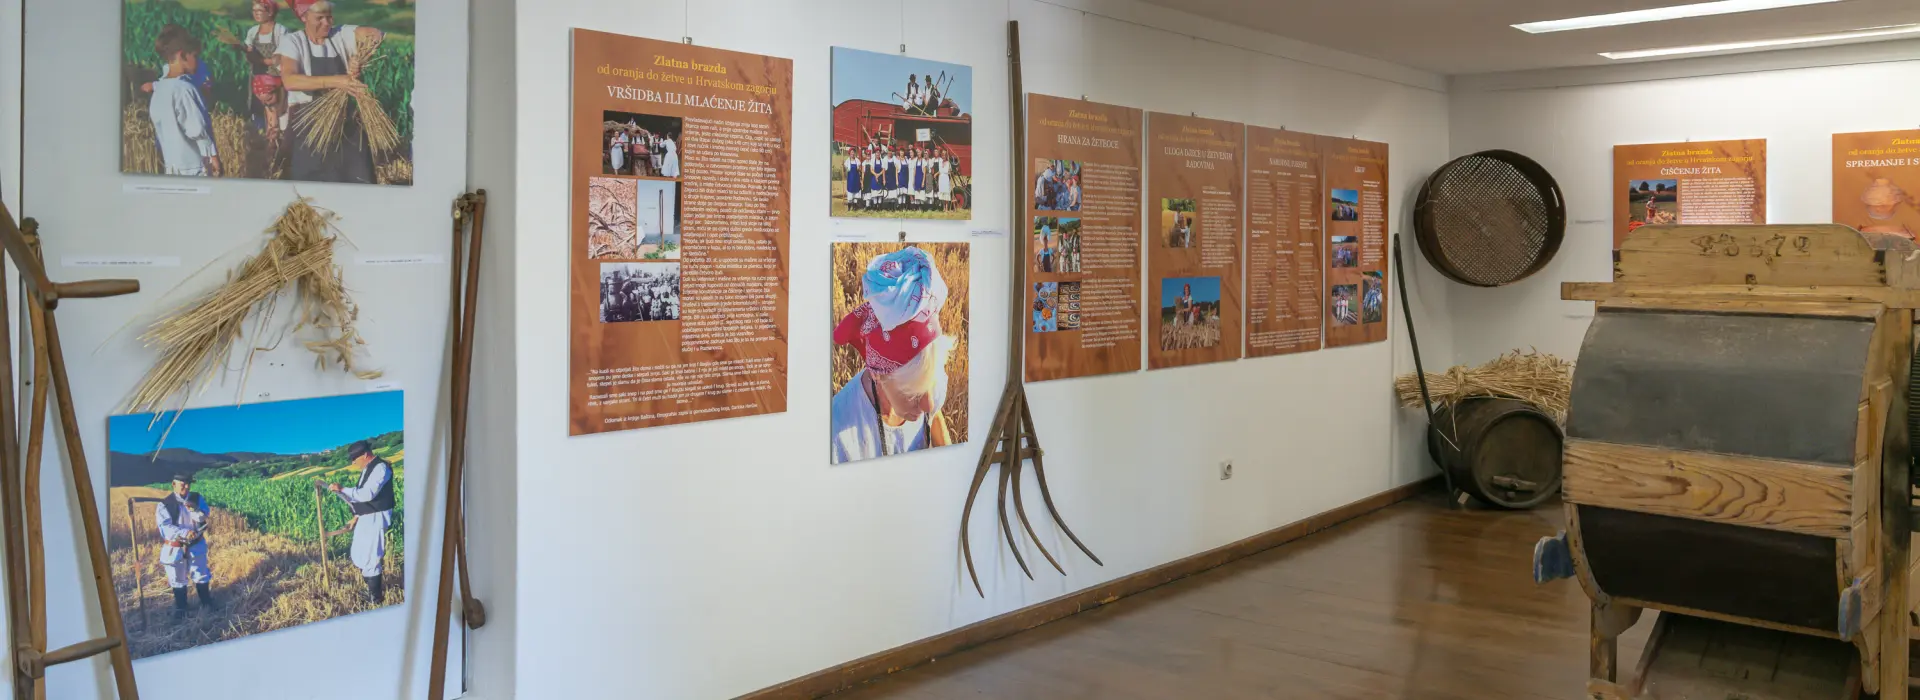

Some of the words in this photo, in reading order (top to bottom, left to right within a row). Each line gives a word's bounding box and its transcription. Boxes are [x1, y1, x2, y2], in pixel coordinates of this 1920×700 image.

[654, 54, 688, 69] Zlatna
[692, 58, 726, 74] brazda
[597, 65, 610, 75] od
[612, 68, 644, 80] oranja
[646, 69, 658, 80] do
[661, 72, 684, 84] žetve
[687, 76, 692, 84] u
[696, 76, 744, 91] Hrvatskom
[746, 84, 777, 97] zagorju
[606, 84, 662, 102] VRŠIDBA
[666, 92, 682, 105] ILI
[684, 94, 746, 112] MLAĆENJE
[748, 101, 772, 114] ŽITA
[1068, 110, 1087, 119] Zlatna
[1058, 134, 1081, 146] HRANA
[1082, 136, 1090, 146] ZA
[1092, 136, 1119, 149] ŽETEOCE
[1164, 146, 1184, 156] ULOGA
[1185, 148, 1200, 158] DJECE
[1207, 149, 1232, 160] ŽETVENIM
[1186, 160, 1214, 170] RADOVIMA
[1636, 158, 1656, 166] oranja
[1729, 156, 1753, 165] zagorju
[1846, 158, 1905, 168] SPREMANJE
[1660, 166, 1700, 176] ČIŠĆENJE
[1702, 166, 1722, 174] ŽITA
